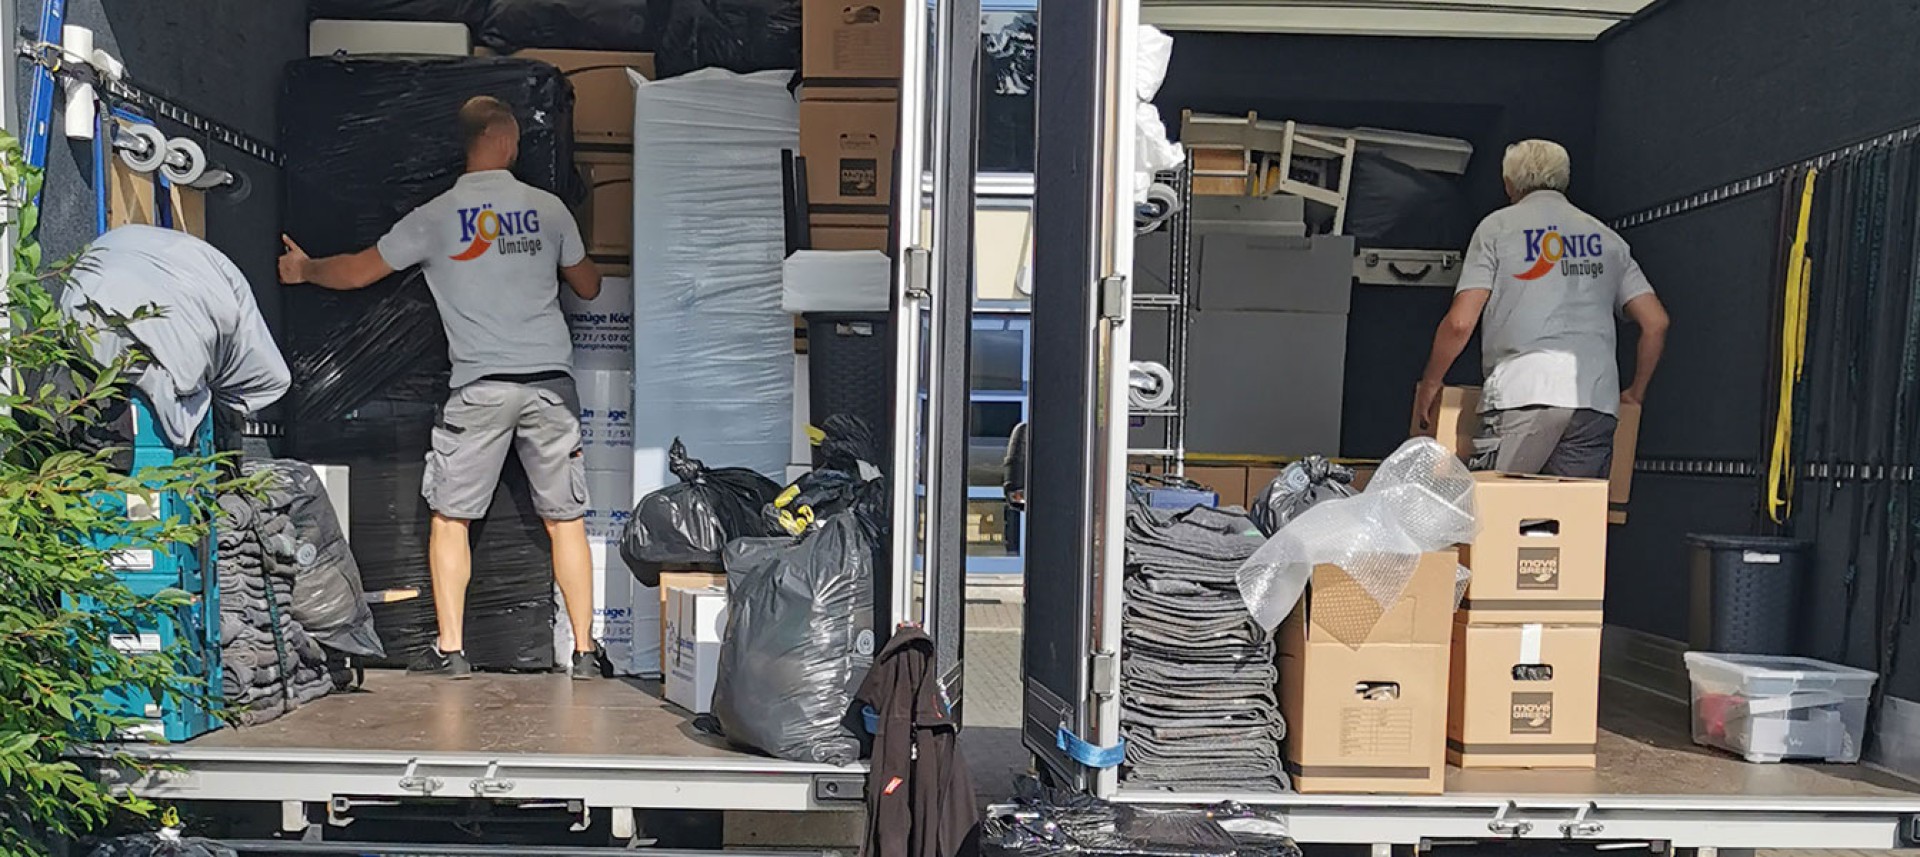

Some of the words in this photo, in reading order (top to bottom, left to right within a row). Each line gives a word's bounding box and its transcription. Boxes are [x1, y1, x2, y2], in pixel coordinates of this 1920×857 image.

[457, 203, 540, 242] KÖNIG
[498, 237, 542, 256] Umzüge
[1523, 225, 1603, 262] KÖNIG
[1561, 260, 1604, 278] Umzüge
[1520, 558, 1557, 568] move
[1513, 702, 1550, 712] move
